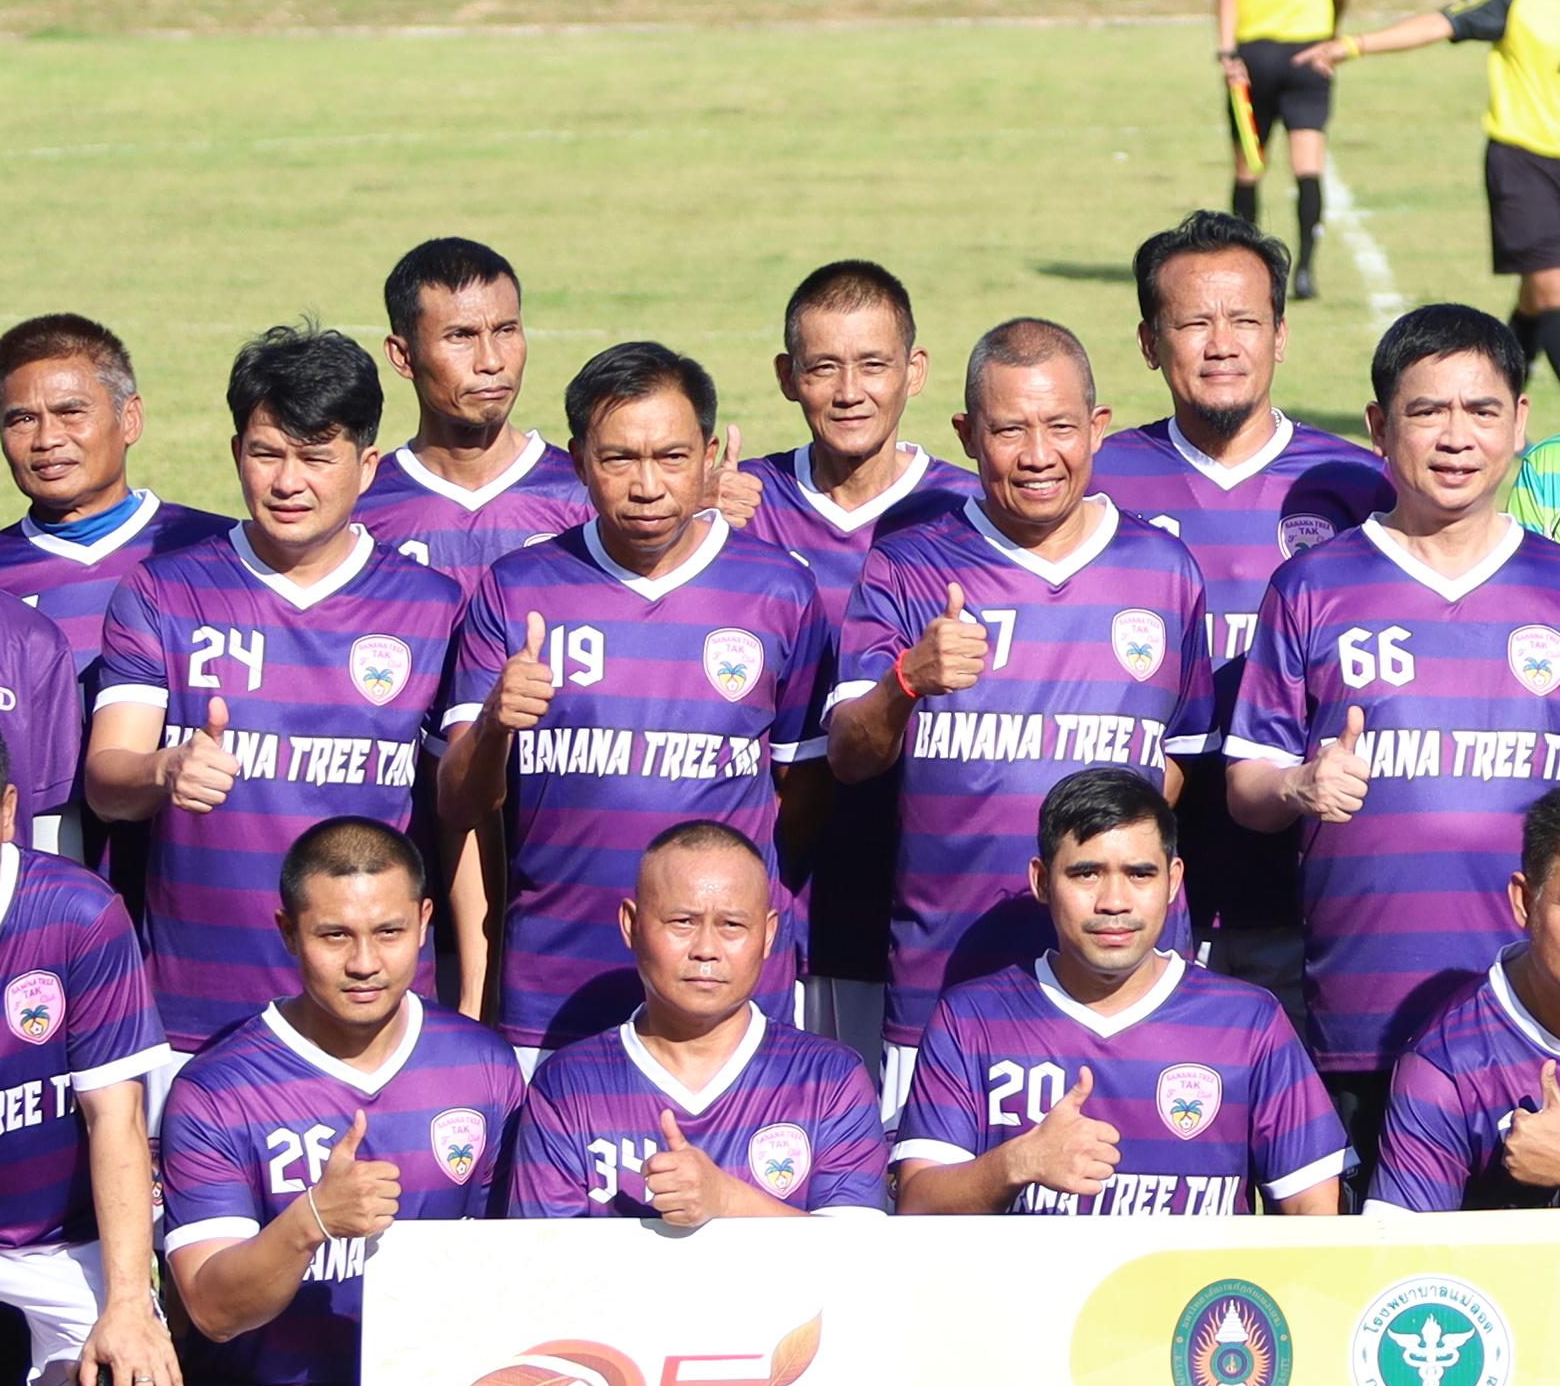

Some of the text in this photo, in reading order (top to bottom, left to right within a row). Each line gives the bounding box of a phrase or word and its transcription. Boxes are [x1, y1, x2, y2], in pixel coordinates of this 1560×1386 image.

[188, 625, 265, 692] 24
[548, 624, 604, 688] 19
[959, 608, 1017, 671] 7
[1338, 625, 1416, 689] 66
[288, 735, 372, 786] TREE
[518, 727, 632, 778] BANANA
[641, 731, 725, 781] TREE
[914, 711, 1043, 763] BANANA
[1054, 714, 1136, 765] TREE
[1451, 729, 1537, 782] TREE
[23, 986, 43, 998] TAK
[988, 1059, 1066, 1126] 20
[1179, 1079, 1201, 1090] TAK
[451, 1125, 471, 1134] TAK
[765, 1140, 788, 1149] TAK
[585, 1137, 655, 1205] 34
[1093, 1174, 1176, 1216] TREE
